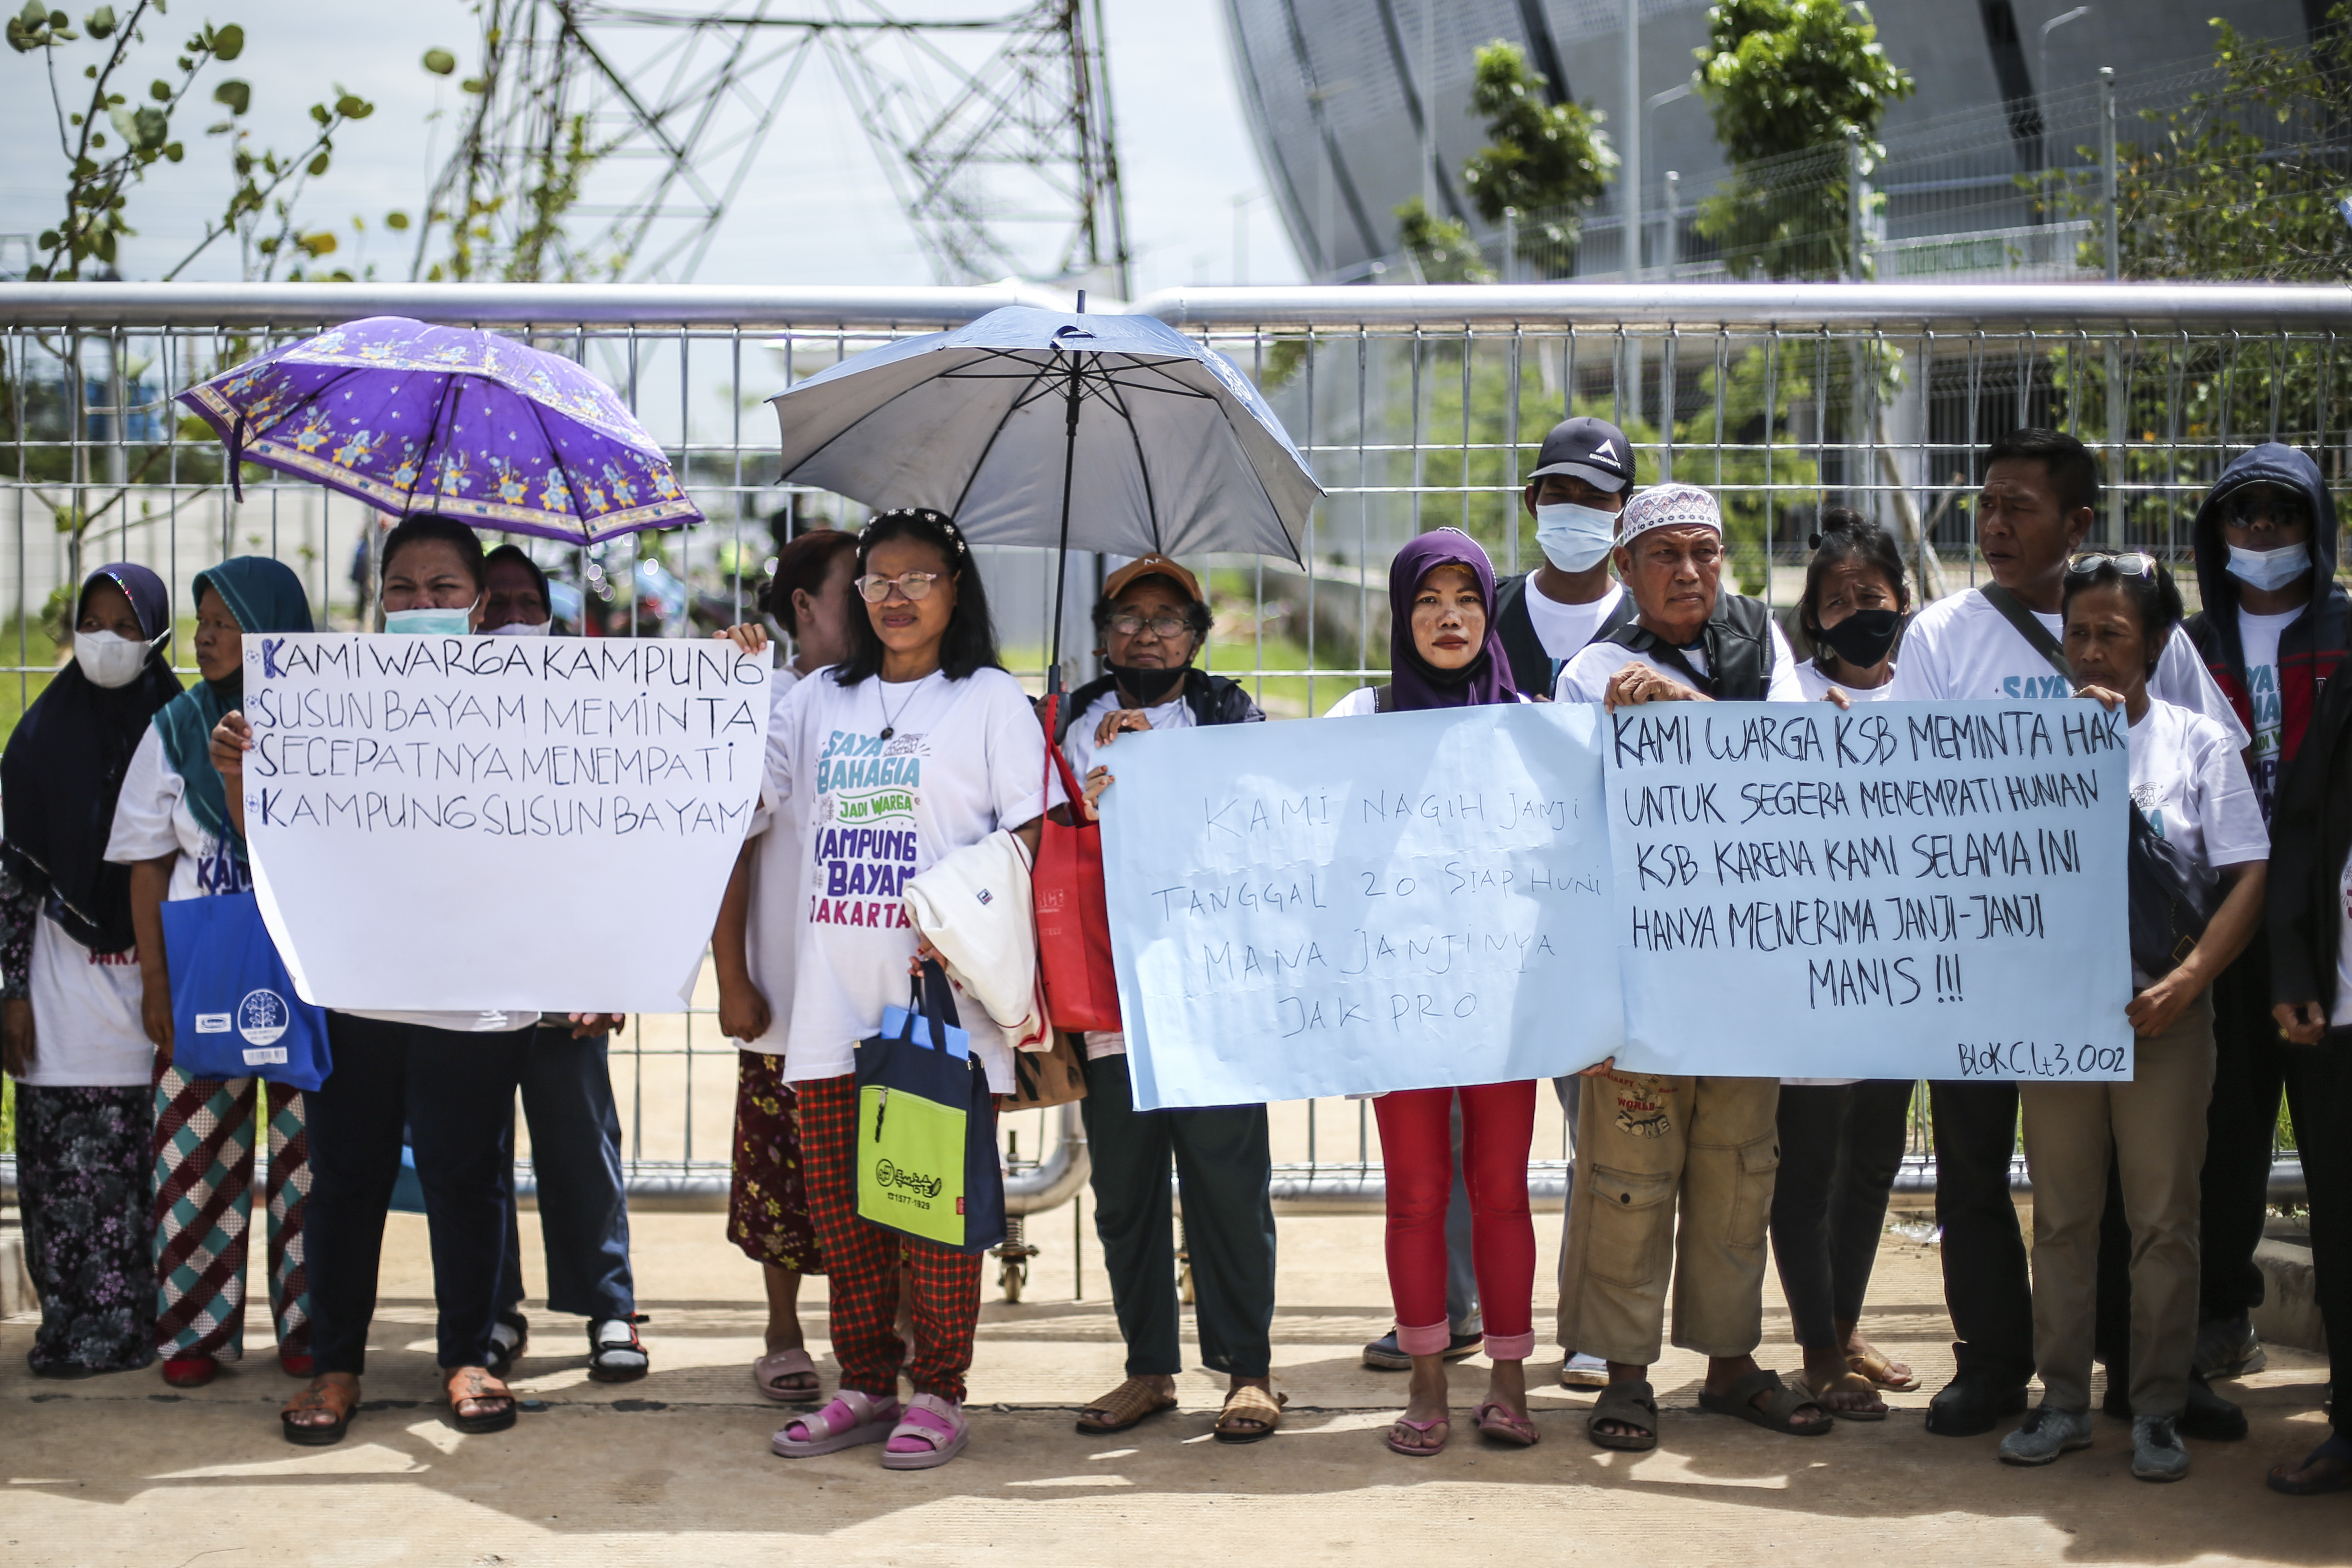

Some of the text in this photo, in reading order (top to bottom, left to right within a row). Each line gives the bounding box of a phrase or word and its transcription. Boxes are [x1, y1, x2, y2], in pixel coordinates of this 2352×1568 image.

[368, 638, 534, 677] WARGA
[544, 643, 764, 691] KAMPUNG
[253, 688, 373, 729] SUSUN
[384, 690, 526, 732] BAYAM
[255, 733, 513, 783] SECEPATNYA
[822, 730, 884, 759] SAYA
[1611, 710, 2128, 769] KAMI WARGA KSB MEMINTA HAK
[817, 757, 920, 794] BAHAGIA
[1624, 769, 2098, 828] UNTUK SEGERA MENEMPATI HUNIAN
[261, 787, 751, 836] KAMPUNG SUSUN BAYAM
[840, 794, 912, 817] JADI WARGA
[1364, 790, 1484, 827] NAGIH
[1637, 828, 2080, 891] KSB KARENA KAMI SELAMA INI
[1151, 873, 1327, 921] TANGGAL
[1362, 872, 1416, 897] 20
[1444, 861, 1515, 898] SIAP
[1633, 893, 2044, 952] HANYA MENERIMA JANJI-JANJI
[1203, 941, 1327, 984] MANA
[1809, 957, 1921, 1009] MANIS
[1277, 992, 1477, 1038] JAK PRO
[1617, 1097, 1655, 1111] WORLD
